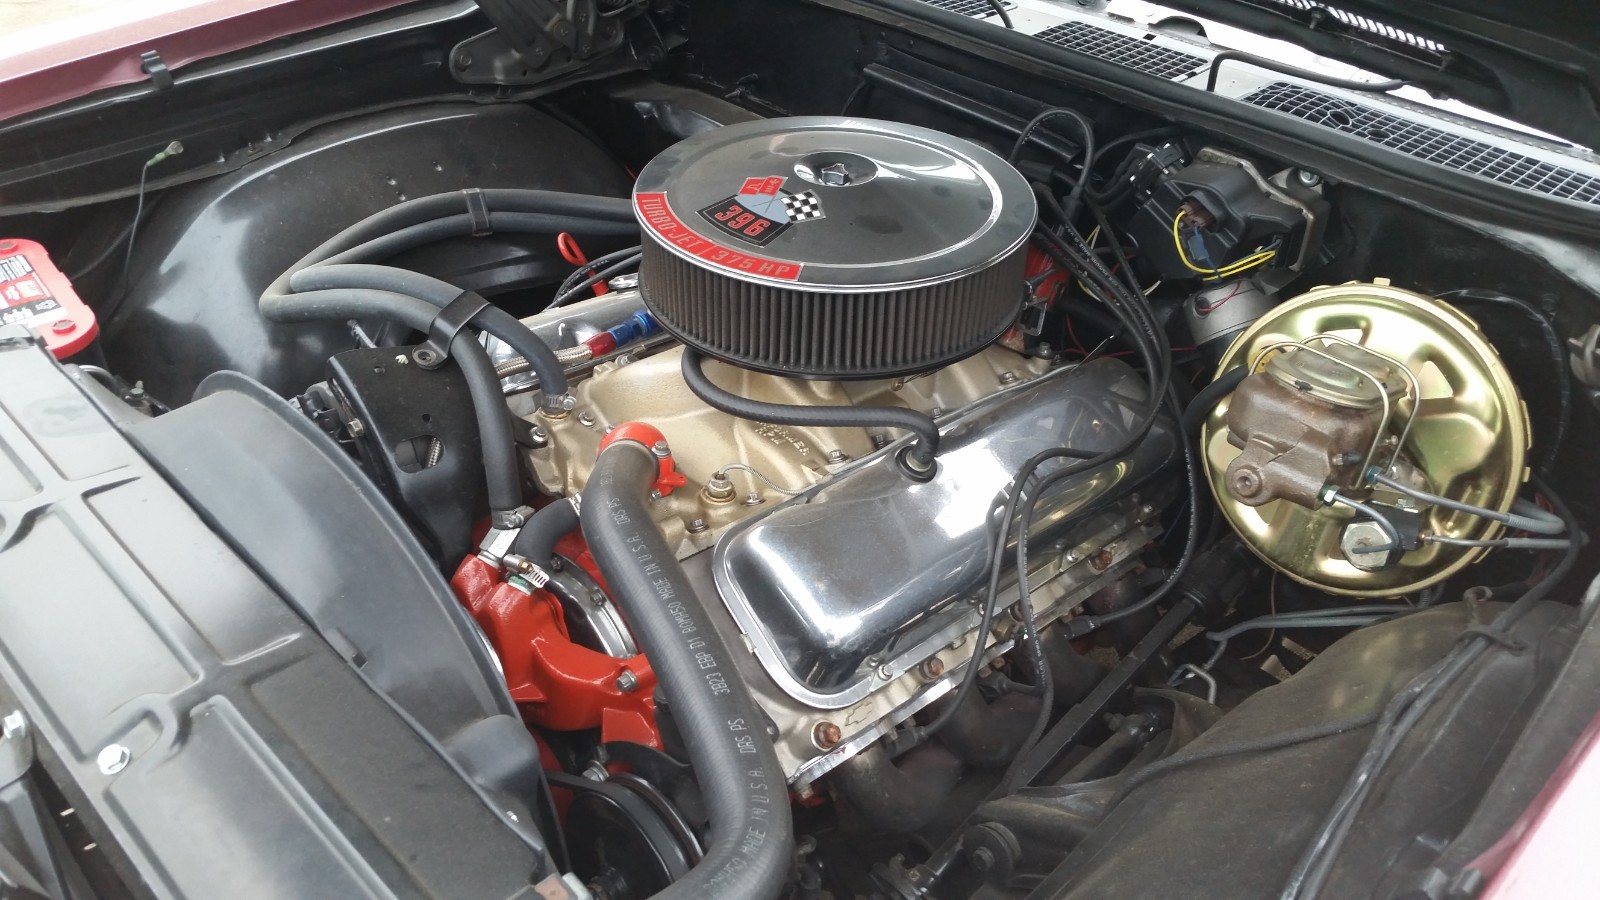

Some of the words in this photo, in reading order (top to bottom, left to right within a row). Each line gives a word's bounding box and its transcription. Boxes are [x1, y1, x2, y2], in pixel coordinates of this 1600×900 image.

[714, 205, 771, 236] 396
[641, 197, 702, 249] TURBO-JET
[711, 251, 752, 269] 375
[759, 262, 790, 276] HP
[606, 497, 620, 509] PS
[644, 562, 661, 576] IN
[652, 577, 676, 601] MADE
[695, 651, 717, 670] EBP
[705, 672, 731, 696] 3B23
[727, 718, 748, 731] PS
[751, 807, 770, 821] IN
[741, 826, 767, 857] MADE
